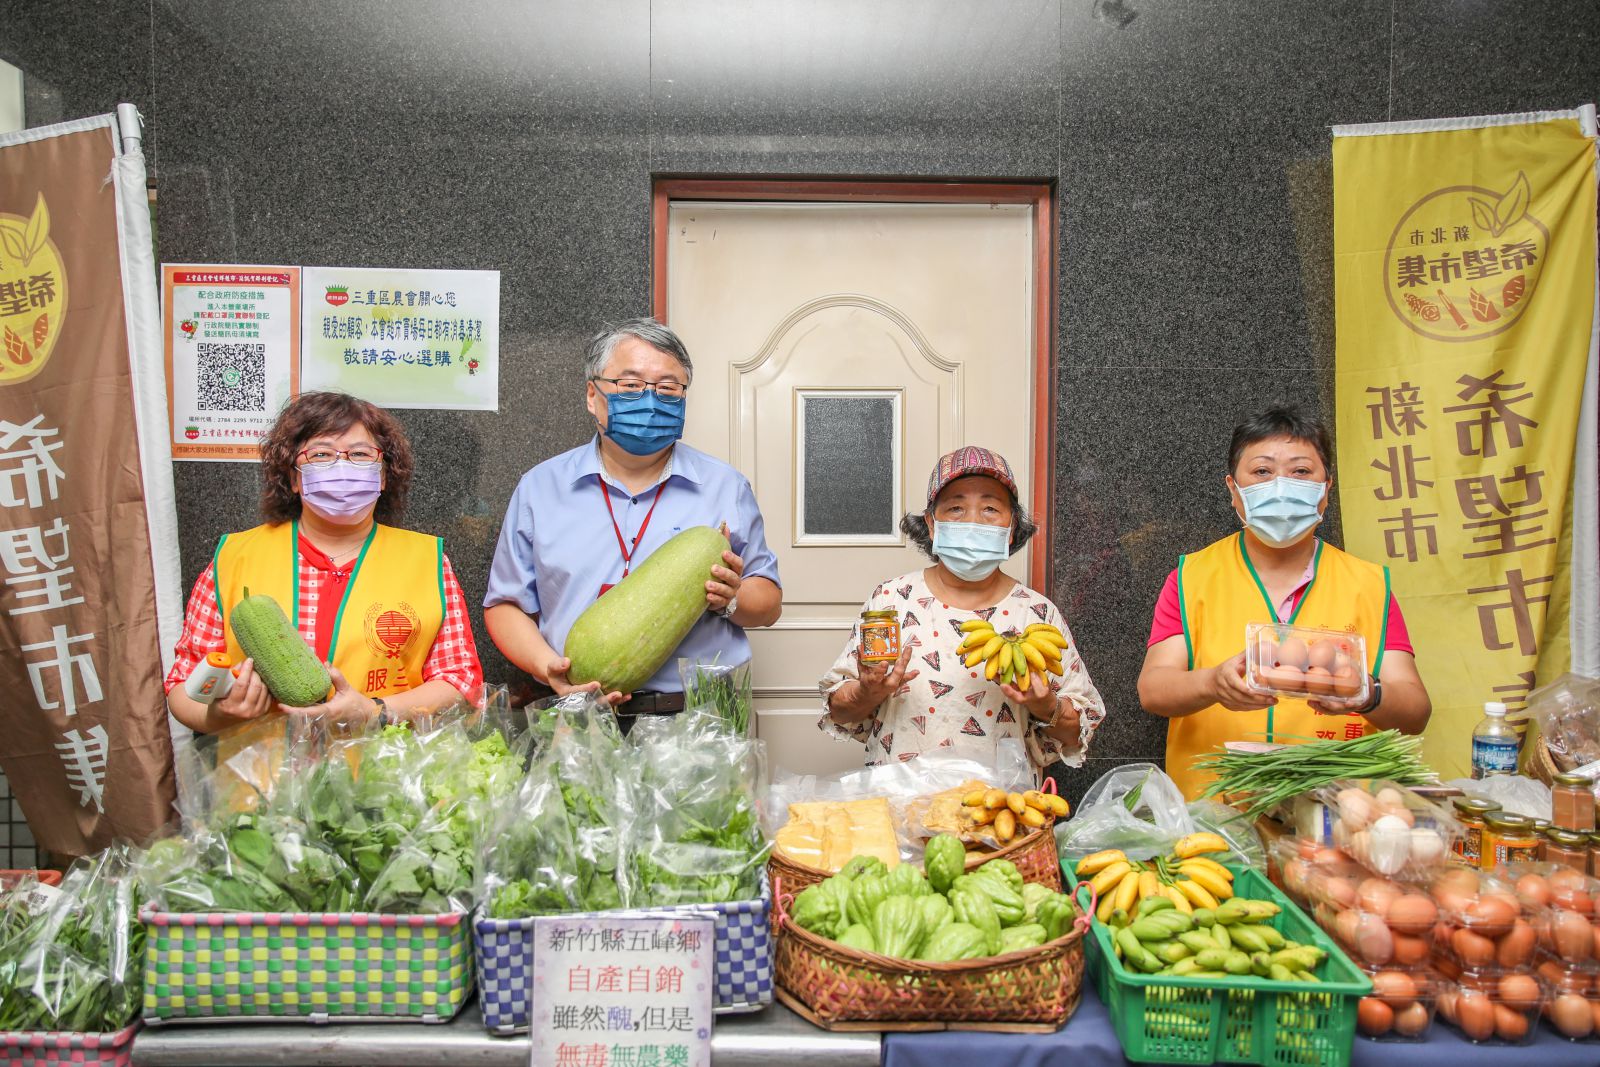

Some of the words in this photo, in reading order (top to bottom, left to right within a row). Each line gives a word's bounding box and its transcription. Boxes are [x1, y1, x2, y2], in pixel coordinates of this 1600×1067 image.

[198, 290, 265, 300] 配合政府防疫措施
[351, 289, 457, 308] 三重區農會關心您
[343, 348, 453, 367] 敬請安心選購
[549, 927, 702, 952] 新竹縣五峰鄉
[568, 964, 685, 993] 自產自銷
[555, 1041, 690, 1067] 無毒無農藥
